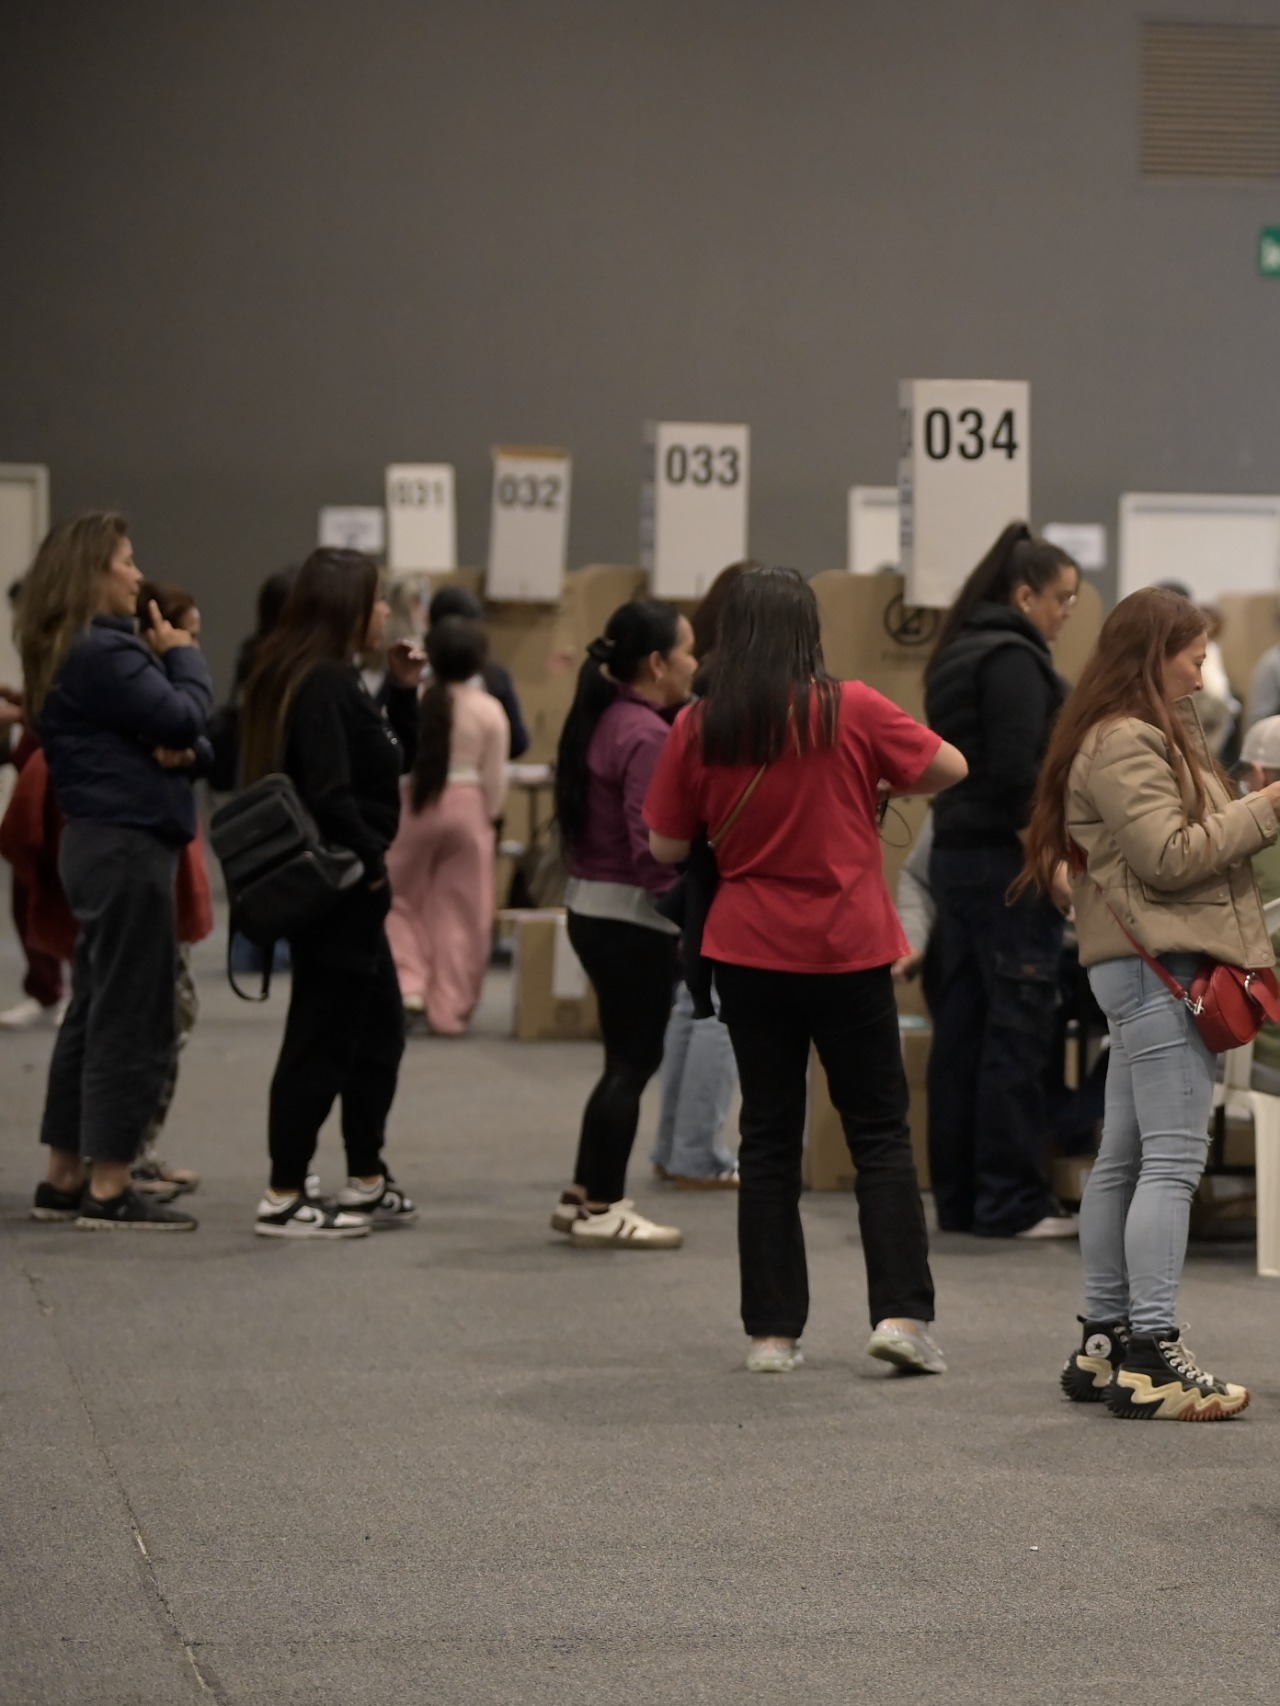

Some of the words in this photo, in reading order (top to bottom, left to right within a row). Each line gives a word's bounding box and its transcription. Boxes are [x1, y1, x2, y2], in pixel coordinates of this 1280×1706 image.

[923, 406, 1018, 461] 034
[665, 443, 740, 488] 033
[500, 473, 562, 512] 032
